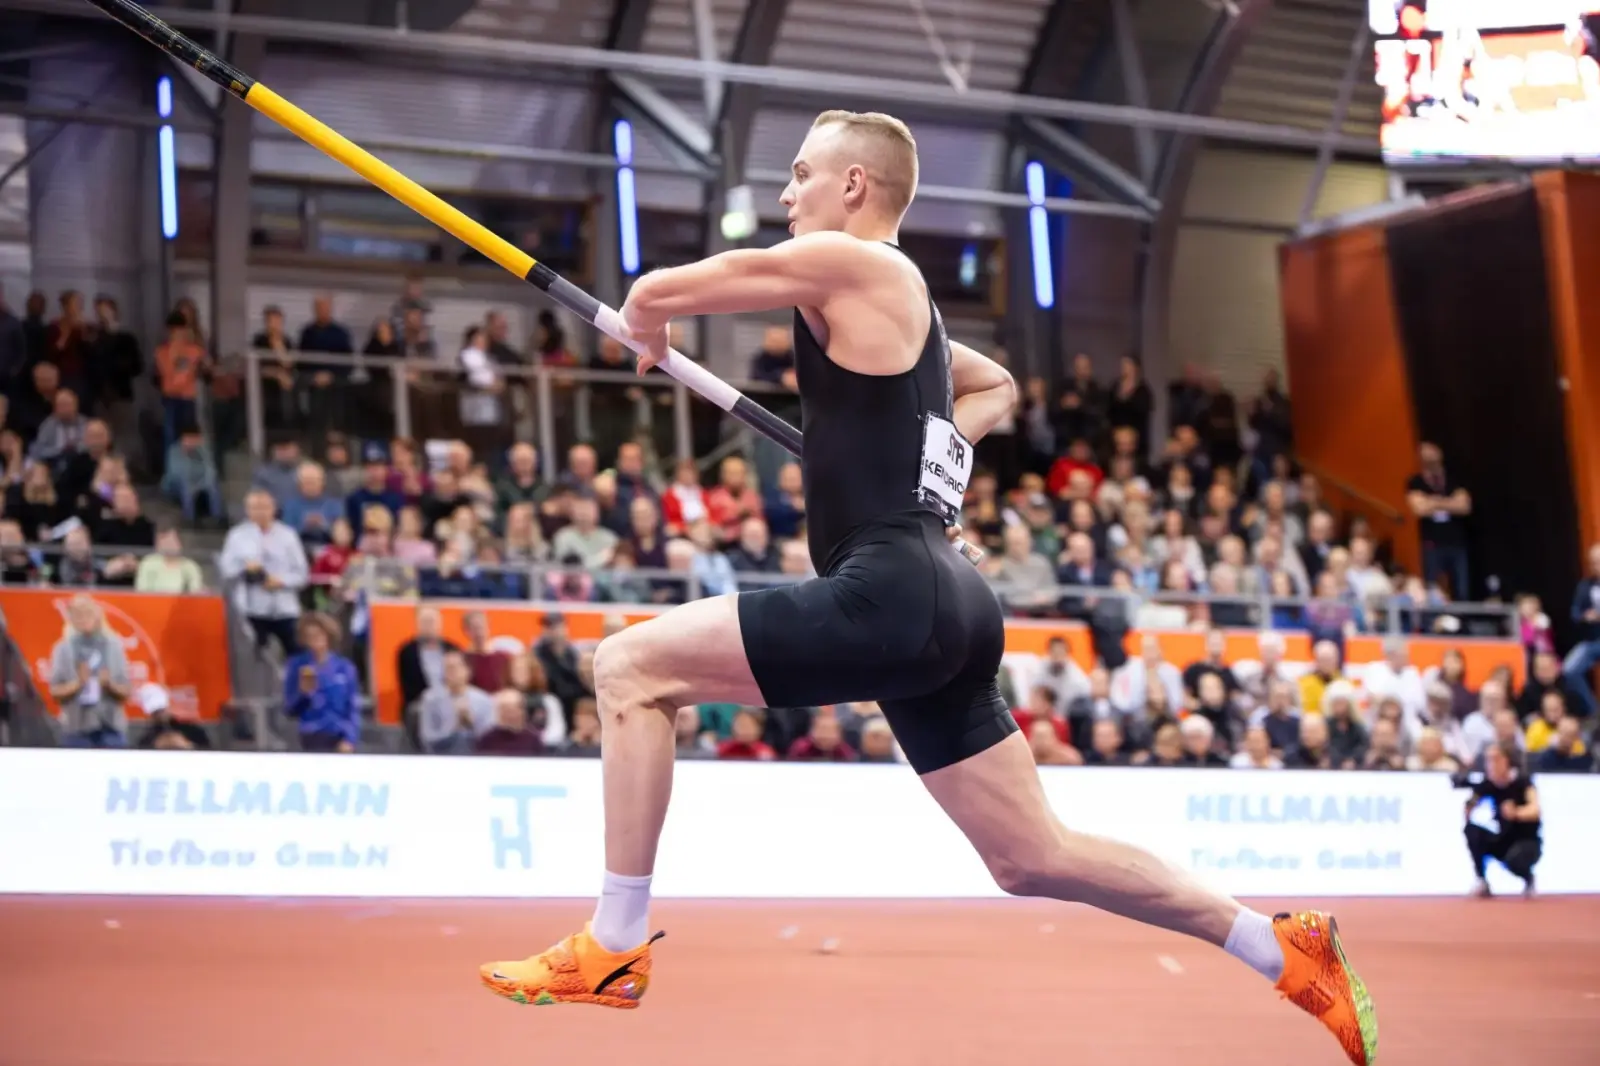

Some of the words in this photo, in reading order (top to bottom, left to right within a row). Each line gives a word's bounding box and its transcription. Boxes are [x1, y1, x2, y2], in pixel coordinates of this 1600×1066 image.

[104, 776, 391, 817] HELLMANN
[1186, 794, 1403, 824] HELLMANN
[109, 838, 256, 867] Tiefbau
[274, 841, 391, 868] GmbH
